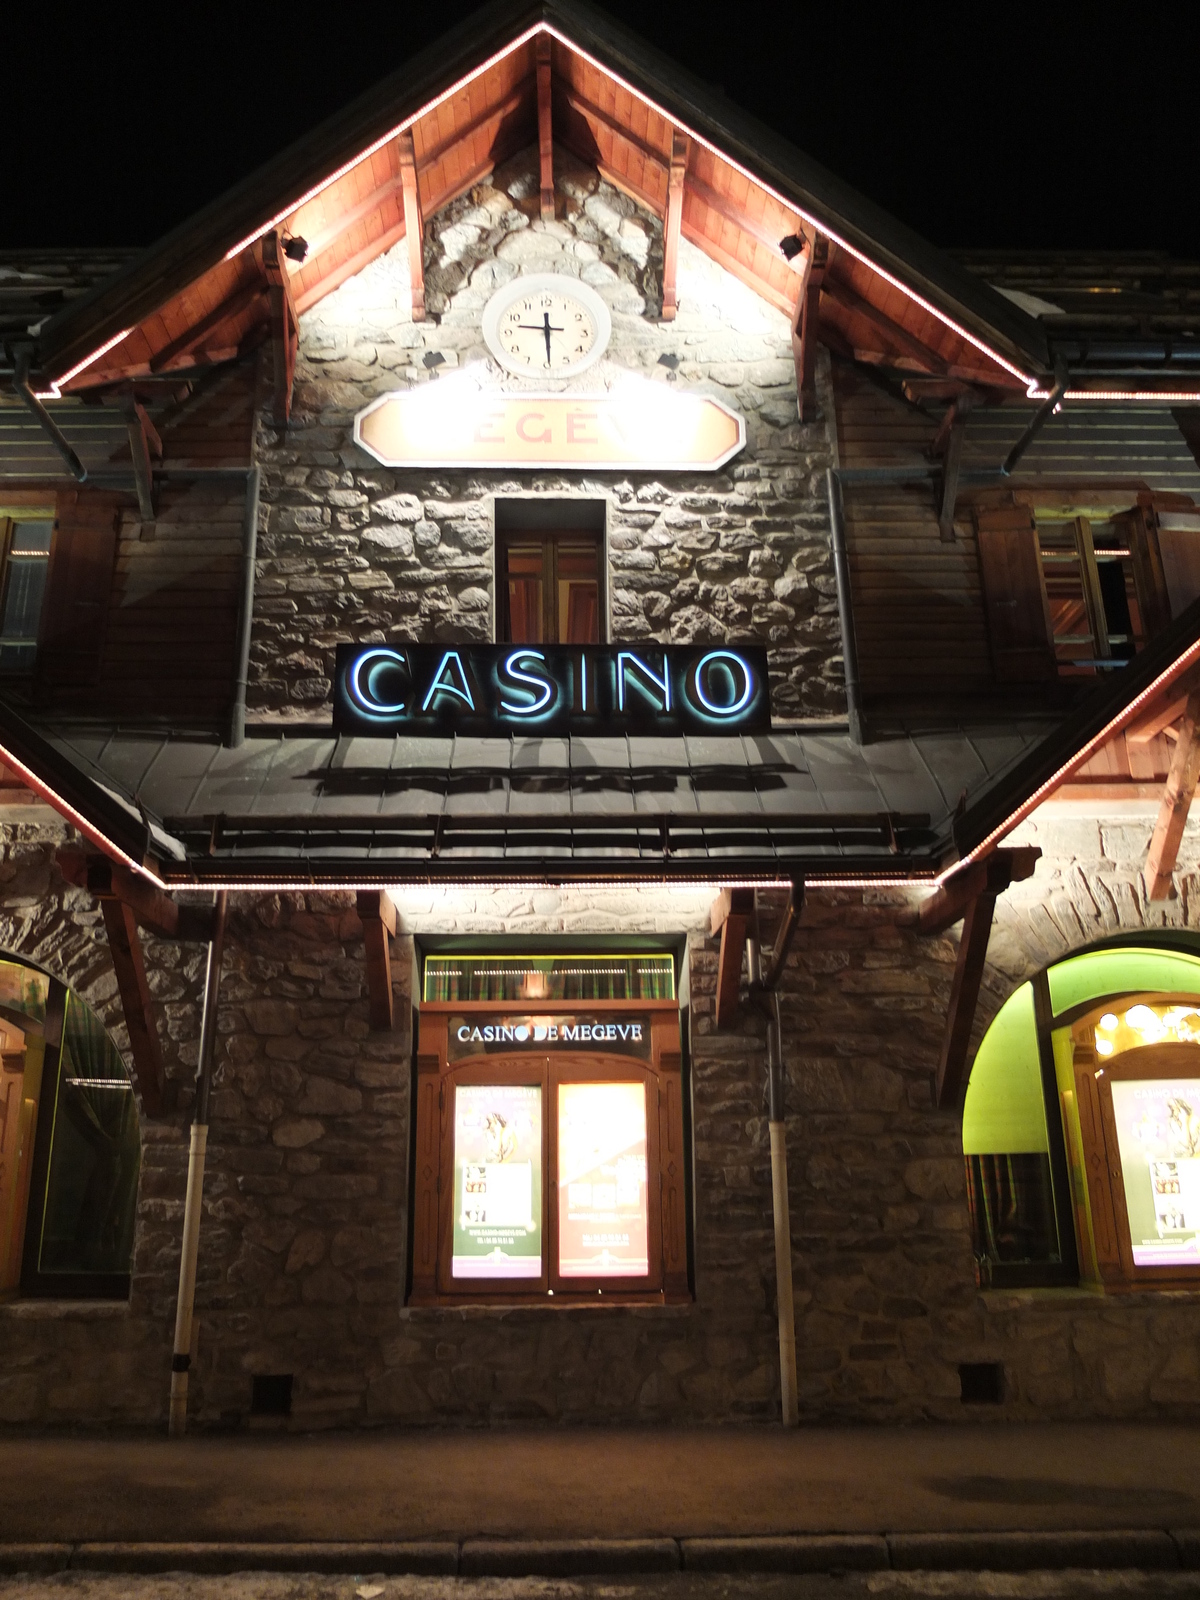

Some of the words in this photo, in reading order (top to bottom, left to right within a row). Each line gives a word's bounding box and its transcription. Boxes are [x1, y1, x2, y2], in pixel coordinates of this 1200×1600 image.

[348, 650, 757, 719] CASINO
[457, 1025, 529, 1042] CASINO
[533, 1025, 558, 1042] DE
[563, 1024, 642, 1041] MEGEVE
